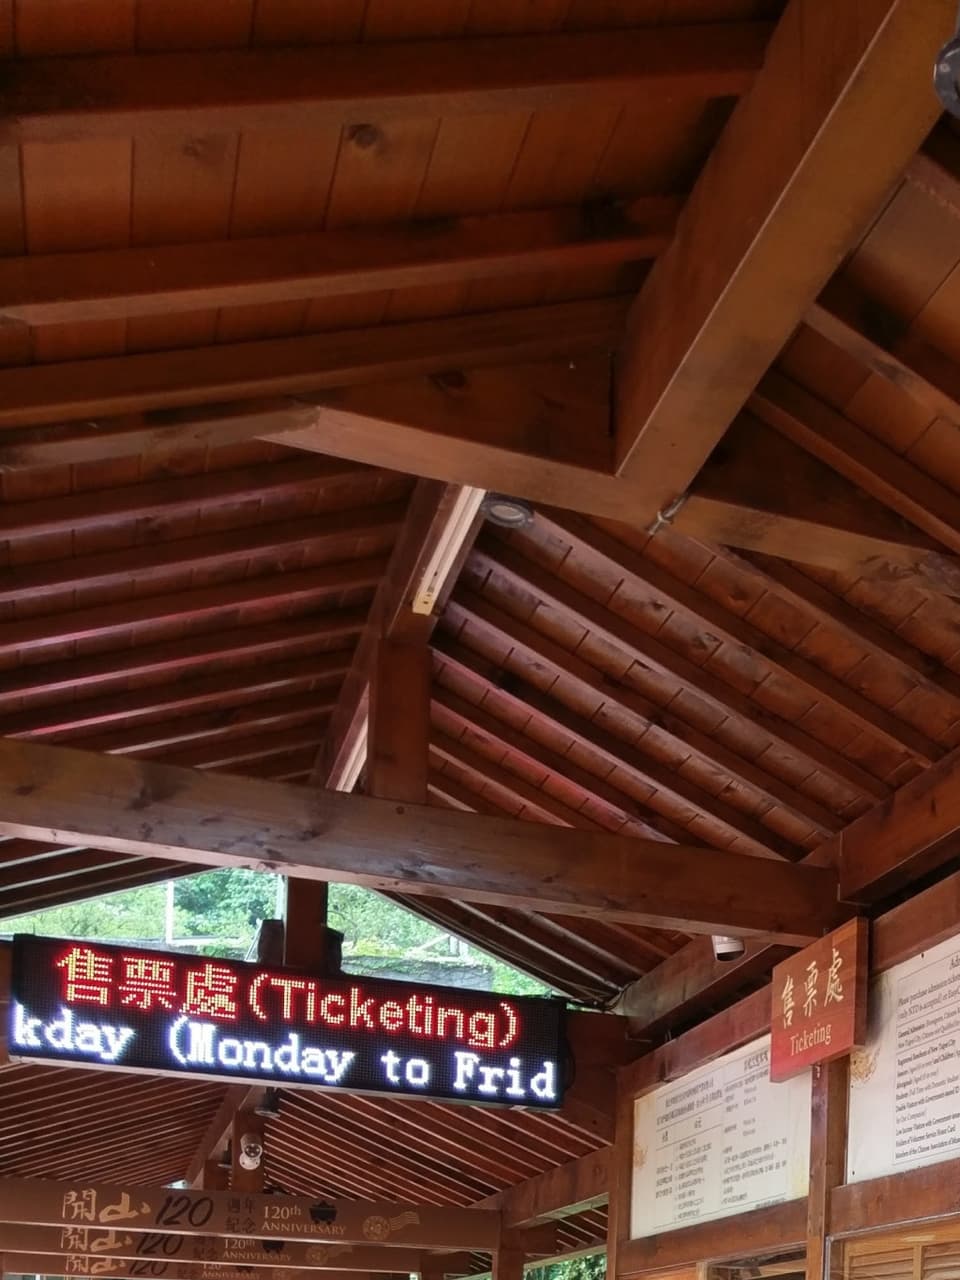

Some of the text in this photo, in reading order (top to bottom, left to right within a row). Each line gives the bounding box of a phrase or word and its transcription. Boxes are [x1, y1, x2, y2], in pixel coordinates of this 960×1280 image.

[781, 947, 844, 1030] 售票處
[789, 1022, 832, 1057] Ticketing
[170, 1015, 354, 1082] (Monday
[381, 1050, 429, 1085] to
[454, 1052, 555, 1099] Frid
[155, 1195, 214, 1227] 120
[263, 1204, 302, 1220] 120th
[261, 1221, 347, 1236] ANNIVERSARY
[222, 1251, 292, 1262] ANNIVERSARY
